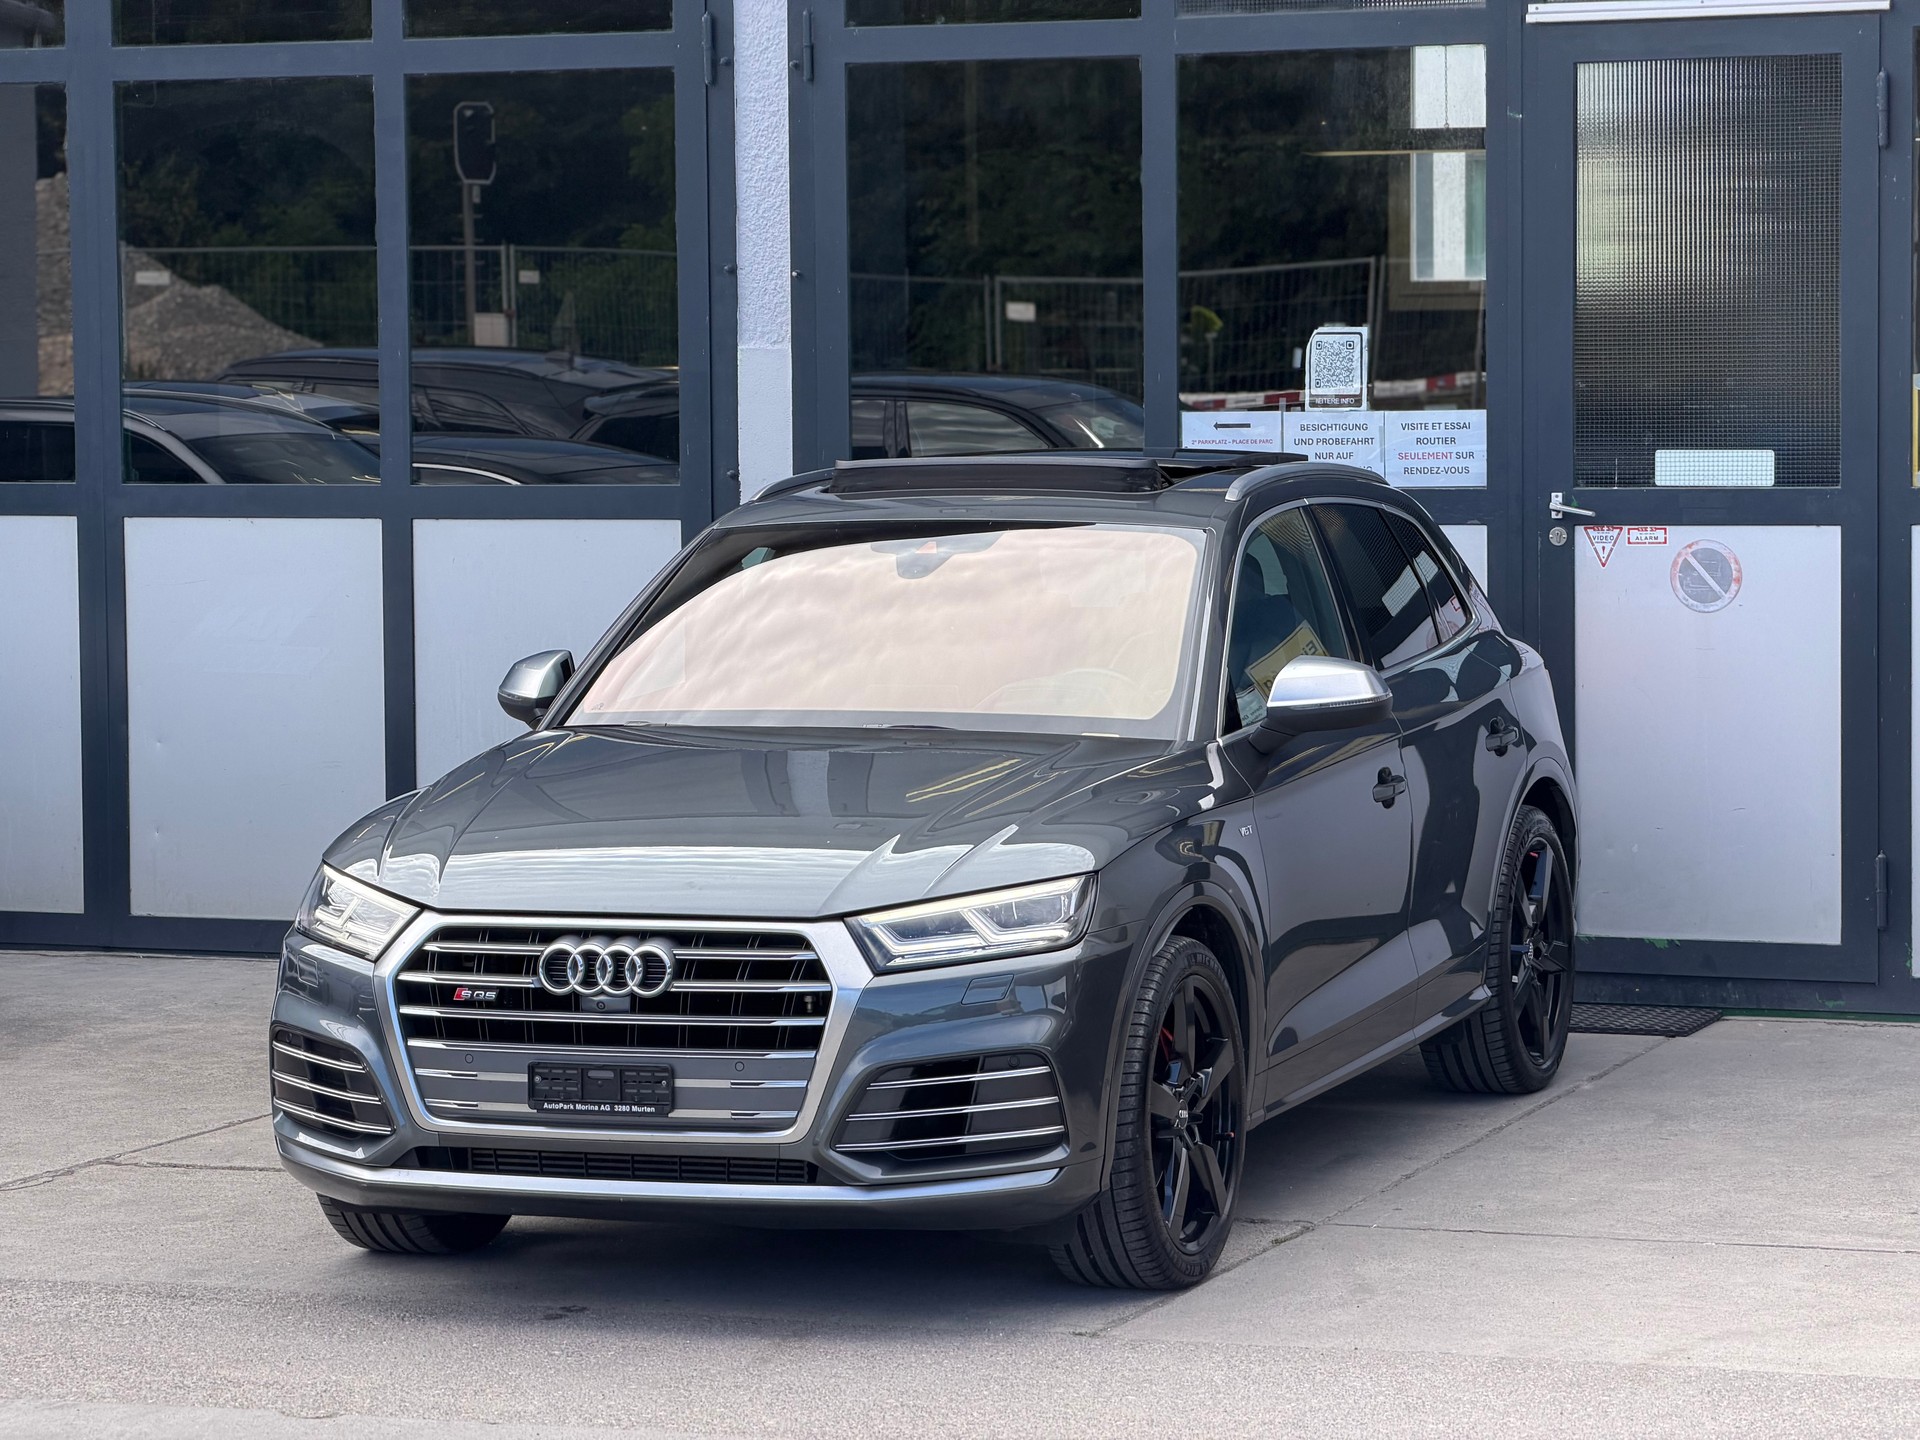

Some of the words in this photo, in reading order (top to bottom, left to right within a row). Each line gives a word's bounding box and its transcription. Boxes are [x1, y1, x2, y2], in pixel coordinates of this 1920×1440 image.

[1300, 423, 1368, 432] BESICHTIGUNG
[1400, 422, 1430, 430] VISITE
[1432, 422, 1442, 430] ET
[1444, 422, 1471, 430] ESSAI
[1316, 437, 1374, 446] PROBEFAHRT
[1416, 437, 1456, 445] ROUTIER
[1398, 452, 1453, 460] SEULEMENT
[1455, 451, 1475, 460] SUR
[1403, 466, 1470, 475] RENDEZ-VOUS
[454, 988, 498, 1000] SQ5
